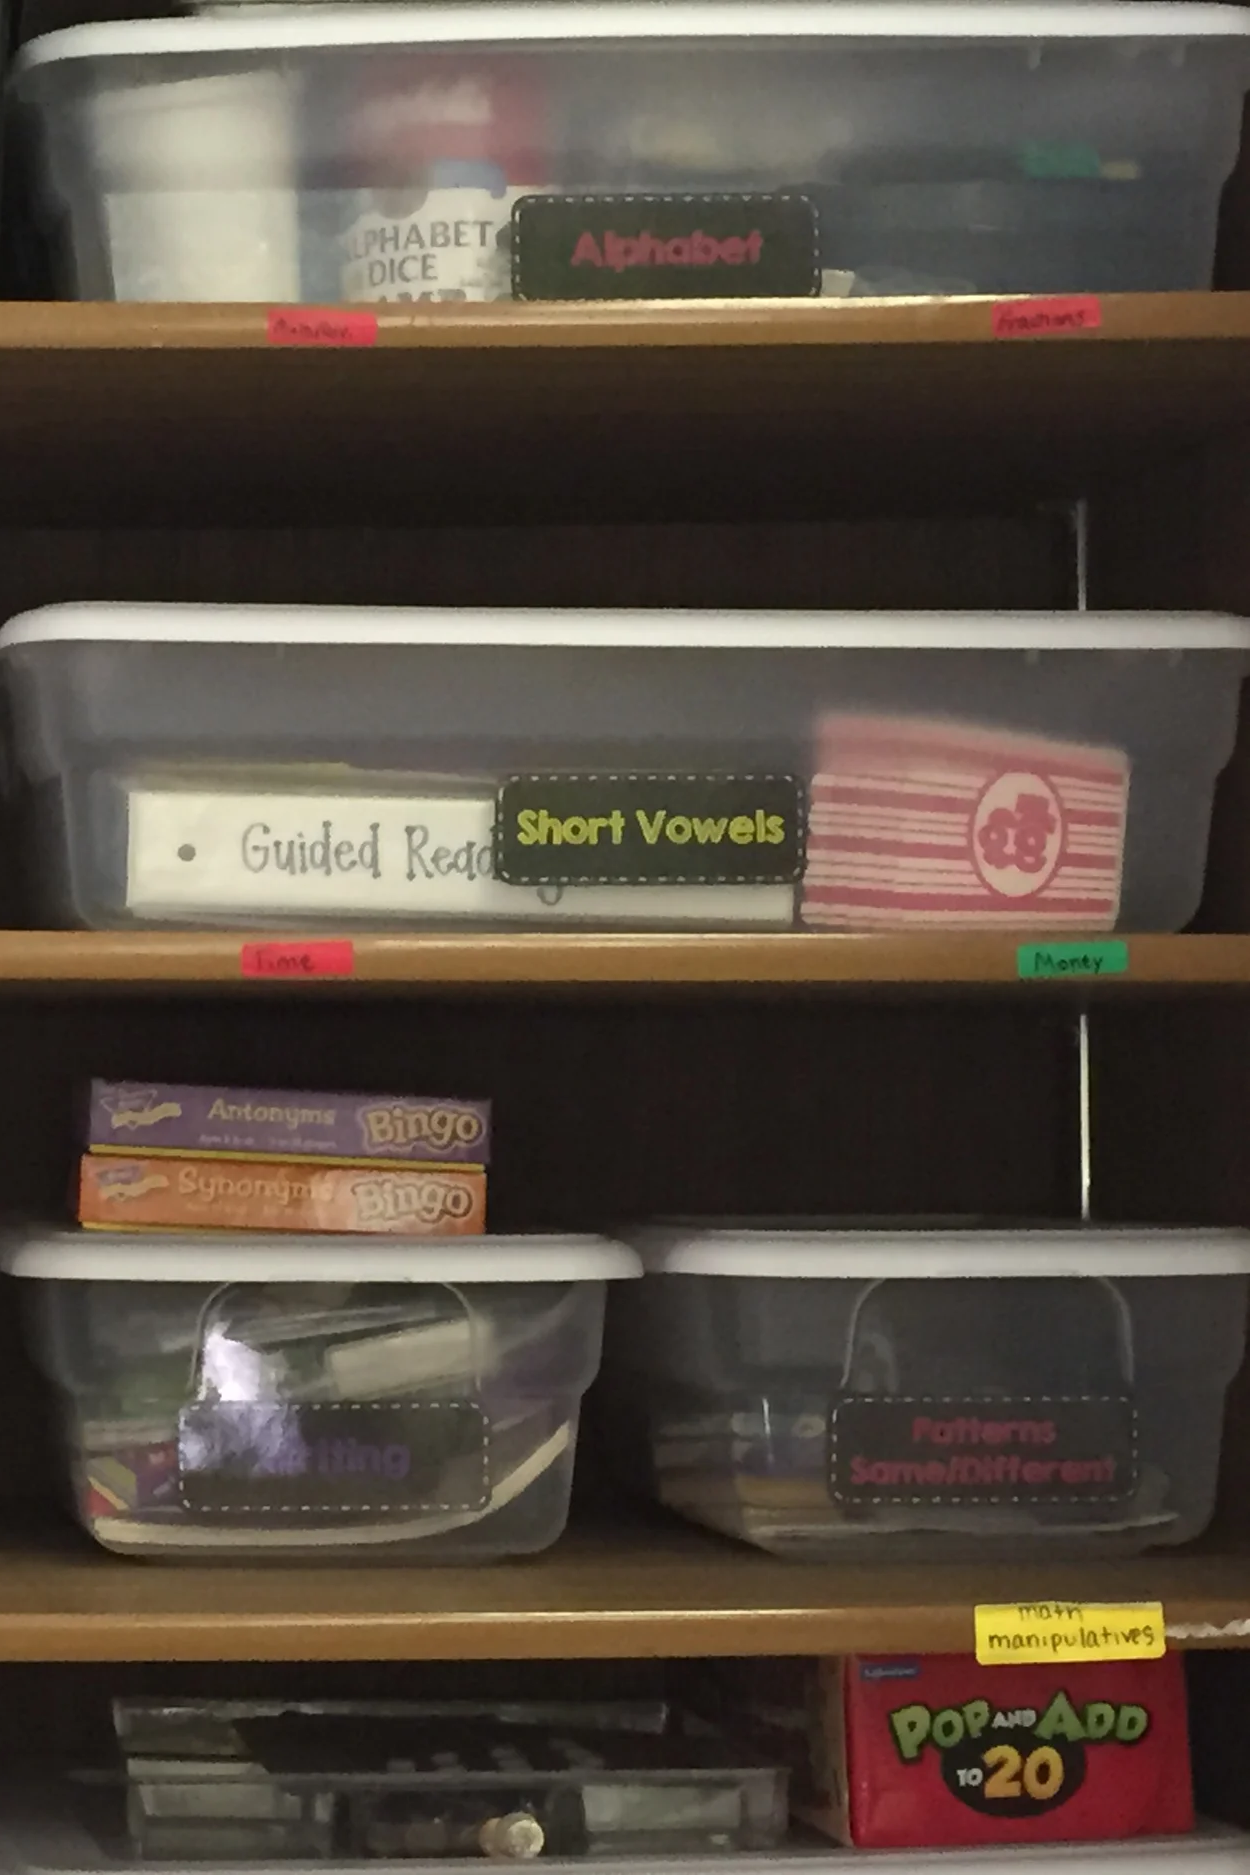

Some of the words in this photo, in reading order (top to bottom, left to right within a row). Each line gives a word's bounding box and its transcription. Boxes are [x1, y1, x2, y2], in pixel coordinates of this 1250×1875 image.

[347, 220, 494, 262] LPHABET
[570, 229, 764, 273] Alphabet
[368, 253, 438, 286] DICE
[516, 809, 626, 845] Short
[635, 809, 785, 845] Vowels
[241, 820, 382, 879] Guided
[1034, 951, 1104, 975] Money
[207, 1097, 337, 1130] Antonyms
[365, 1105, 480, 1148] Bingo
[352, 1180, 472, 1224] Bingo
[911, 1416, 1058, 1445] Patterns
[988, 1624, 1155, 1653] manipulatives
[981, 1744, 1065, 1800] 20
